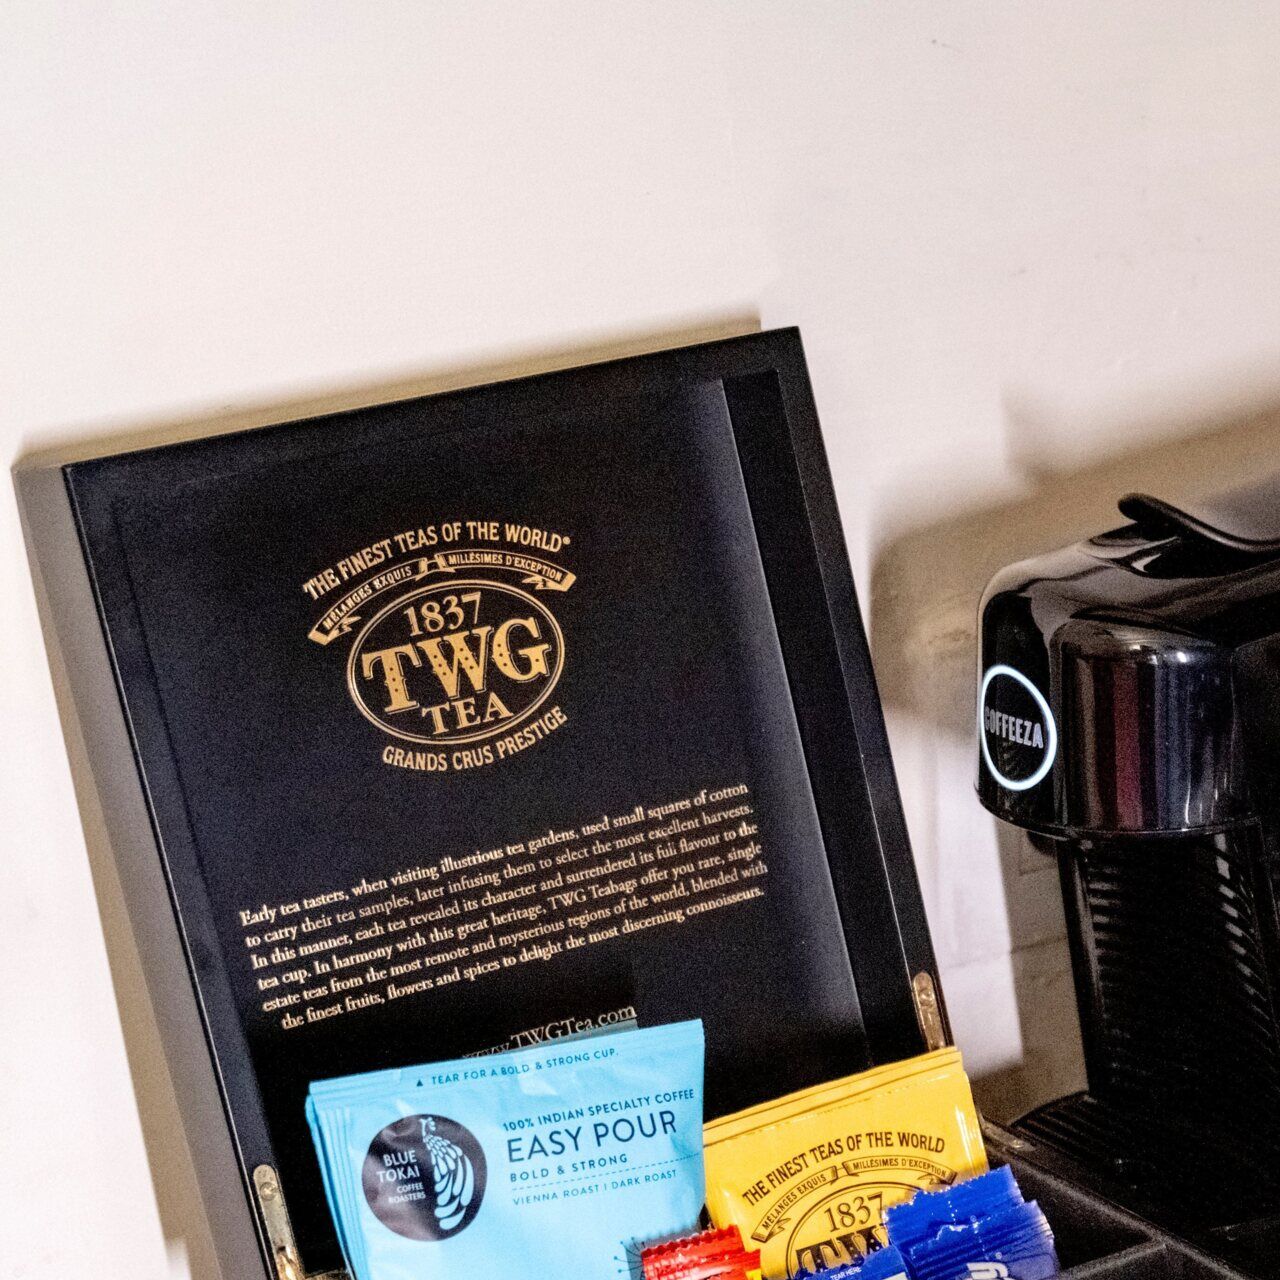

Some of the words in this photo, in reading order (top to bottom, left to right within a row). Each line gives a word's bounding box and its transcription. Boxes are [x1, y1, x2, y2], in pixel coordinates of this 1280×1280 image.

[303, 567, 341, 600] THE
[339, 538, 393, 580] FINEST
[394, 525, 438, 554] TEAS
[442, 523, 462, 542] OF
[466, 522, 499, 540] THE
[374, 566, 412, 588] EXQUIS
[449, 553, 503, 565] MILLÉSIMES
[506, 554, 562, 581] D'EXCEPTION
[404, 591, 482, 636] 1837
[361, 617, 551, 714] TWG
[422, 692, 514, 734] TEA
[984, 706, 1043, 748] COFFEEZA
[383, 745, 447, 771] GRANDS
[452, 745, 493, 770] CRUS
[496, 706, 568, 759] PRESTIGE
[239, 905, 277, 927] Early
[279, 902, 302, 916] tea
[302, 890, 350, 910] tasters,
[351, 879, 388, 897] when
[390, 866, 440, 886] visiting
[440, 848, 504, 873] illustrious
[505, 843, 526, 856] tea
[527, 829, 579, 855] gardens,
[581, 816, 611, 836] used
[612, 807, 646, 828] small
[647, 799, 692, 821] squares
[693, 790, 707, 807] of
[708, 783, 749, 802] cotton
[244, 935, 262, 948] to
[263, 925, 298, 943] carry
[300, 914, 332, 933] their
[335, 910, 356, 924] tea
[358, 895, 414, 918] samples,
[415, 886, 445, 902] later
[448, 872, 502, 893] infusing
[502, 862, 536, 879] them
[538, 858, 553, 870] to
[555, 847, 589, 865] select
[591, 840, 612, 855] the
[612, 832, 646, 849] most
[648, 818, 700, 840] excellent
[701, 805, 754, 826] harvests.
[250, 954, 269, 970] In
[270, 946, 297, 964] this
[298, 934, 353, 957] manner,
[354, 922, 385, 941] each
[387, 919, 408, 932] tea
[409, 900, 461, 926] revealed
[462, 899, 479, 912] its
[480, 884, 537, 907] character
[539, 872, 564, 891] and
[565, 853, 637, 884] surrendered
[638, 852, 655, 865] its
[679, 834, 720, 854] flavour
[723, 830, 737, 842] to
[737, 822, 758, 837] the
[256, 976, 280, 991] tea
[281, 969, 312, 984] cup.
[313, 960, 331, 975] In
[332, 945, 393, 970] harmony
[395, 933, 427, 952] with
[428, 926, 455, 943] this
[456, 918, 489, 940] great
[490, 905, 547, 926] heritage,
[547, 888, 587, 910] TWG
[587, 878, 638, 899] Teabags
[640, 868, 669, 885] offer
[671, 863, 695, 881] you
[697, 855, 726, 870] rare,
[727, 842, 762, 862] single
[262, 993, 301, 1012] estate
[302, 986, 329, 1001] teas
[329, 976, 364, 993] from
[365, 967, 388, 983] the
[389, 959, 423, 977] most
[424, 947, 470, 967] remote
[471, 934, 497, 954] and
[498, 920, 565, 947] mysterious
[567, 908, 612, 929] regions
[612, 897, 627, 915] of
[628, 895, 649, 911] the
[650, 882, 690, 904] world,
[690, 867, 739, 893] blended
[740, 860, 768, 878] with
[281, 1013, 305, 1030] the
[306, 1003, 344, 1023] finest
[345, 993, 385, 1012] fruits,
[387, 979, 434, 1000] flowers
[435, 966, 461, 986] and
[463, 960, 501, 981] spices
[501, 956, 518, 968] to
[518, 941, 563, 963] delight
[565, 934, 587, 950] the
[588, 926, 620, 944] most
[621, 909, 685, 934] discerning
[685, 887, 764, 916] connoisseurs.
[432, 1073, 459, 1085] TEAR
[464, 1070, 486, 1080] FOR
[501, 1064, 530, 1074] BOLD
[547, 1053, 590, 1068] STRONG
[594, 1048, 619, 1058] CUP.
[503, 1118, 534, 1132] 100%
[538, 1109, 584, 1125] INDIAN
[588, 1096, 650, 1116] SPECIALTY
[655, 1089, 694, 1104] COFFEE
[508, 1126, 582, 1163] EASY
[593, 1111, 676, 1147] POUR
[376, 1165, 420, 1182] TOKAI
[383, 1150, 417, 1167] BLUE
[511, 1168, 549, 1182] BOLD
[557, 1165, 564, 1175] &
[572, 1154, 628, 1172] STRONG
[742, 1181, 770, 1206] THE
[768, 1154, 811, 1184] FINEST
[810, 1139, 843, 1163] TEAS
[847, 1135, 863, 1151] OF
[866, 1132, 894, 1147] THE
[897, 1132, 945, 1153] WORLD
[853, 1158, 898, 1170] MILLÉSIMES
[902, 1159, 946, 1176] D'EXCEPTION
[389, 1191, 426, 1203] ROASTERS
[397, 1182, 423, 1193] COFFEE
[513, 1192, 557, 1205] VIENNA
[564, 1185, 599, 1198] ROAST
[612, 1177, 640, 1189] DARK
[645, 1170, 677, 1182] ROAST
[762, 1193, 798, 1231] MÉLANGES
[799, 1174, 827, 1195] EXQUIS
[824, 1192, 883, 1232] 1837
[846, 1267, 862, 1276] HERE
